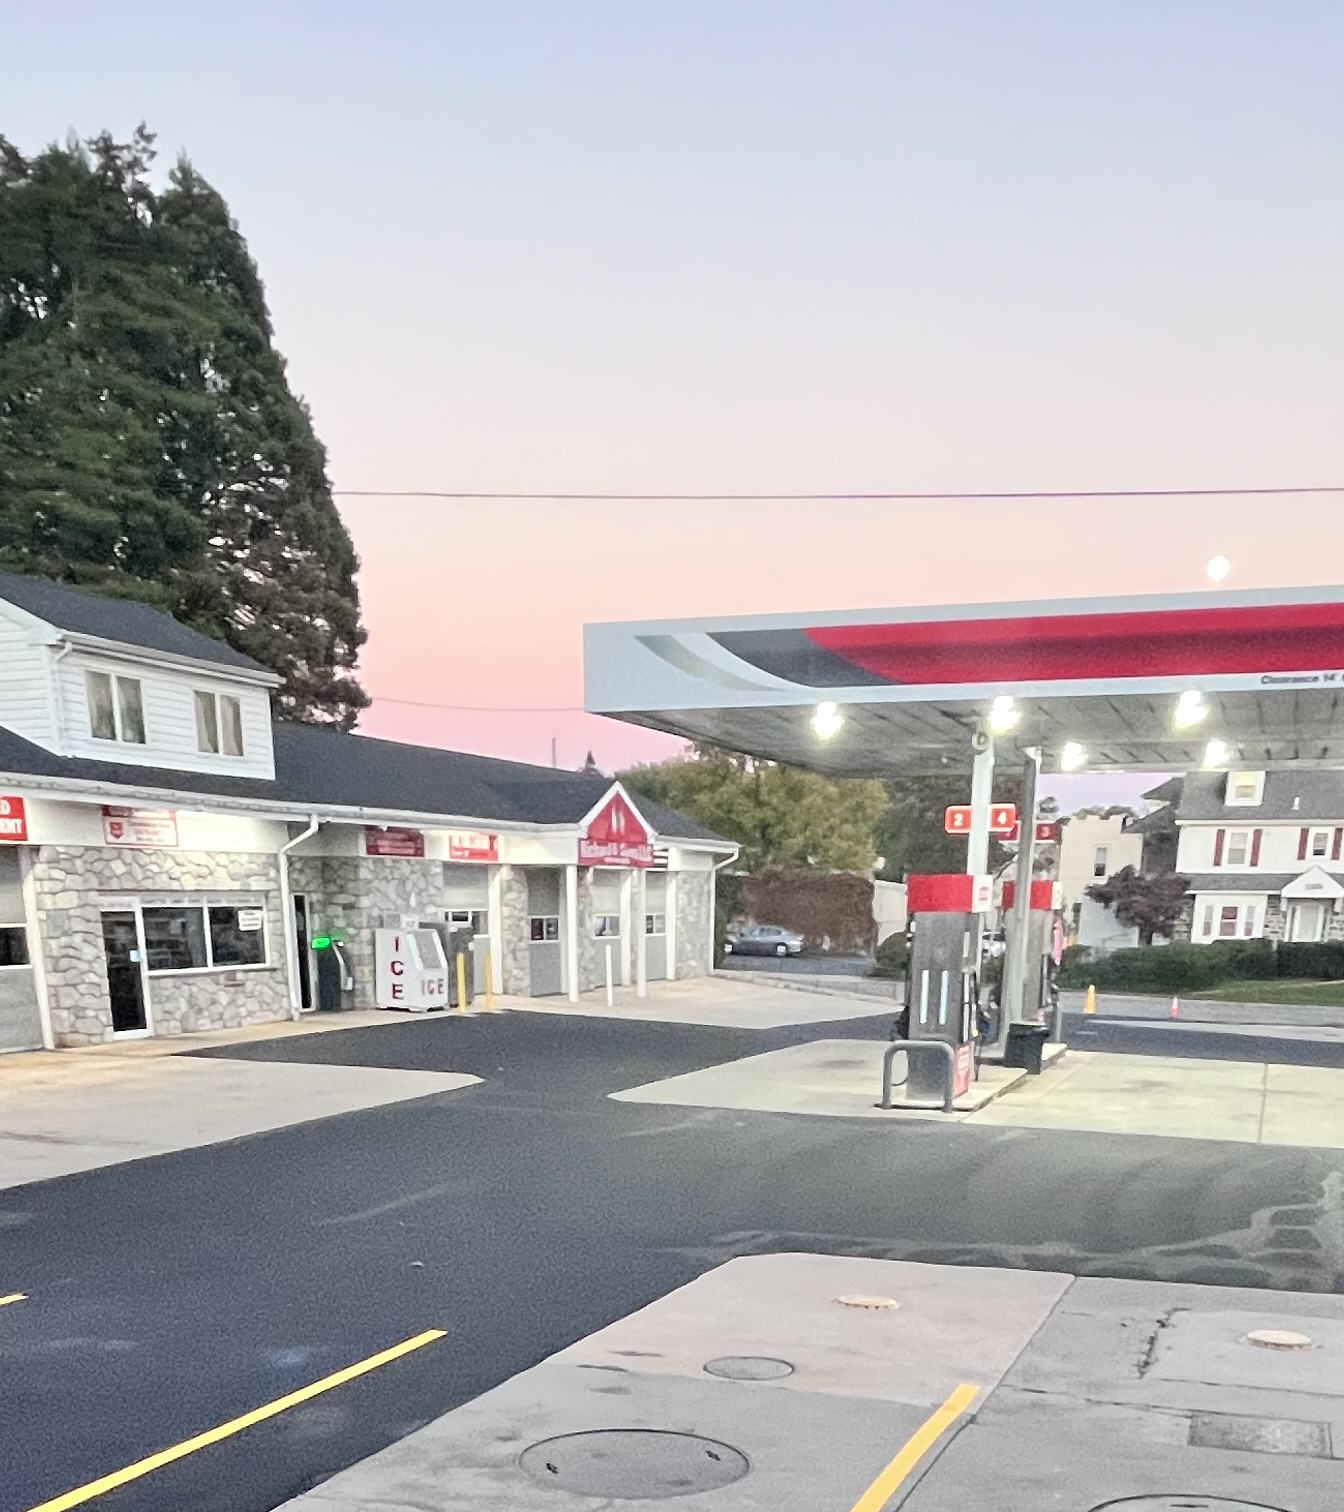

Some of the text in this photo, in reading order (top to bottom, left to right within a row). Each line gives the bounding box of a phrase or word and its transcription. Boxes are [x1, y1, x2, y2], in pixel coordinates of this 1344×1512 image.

[953, 813, 964, 826] 2
[997, 811, 1008, 825] 4
[390, 935, 405, 1001] ICE
[420, 978, 445, 996] ICE
